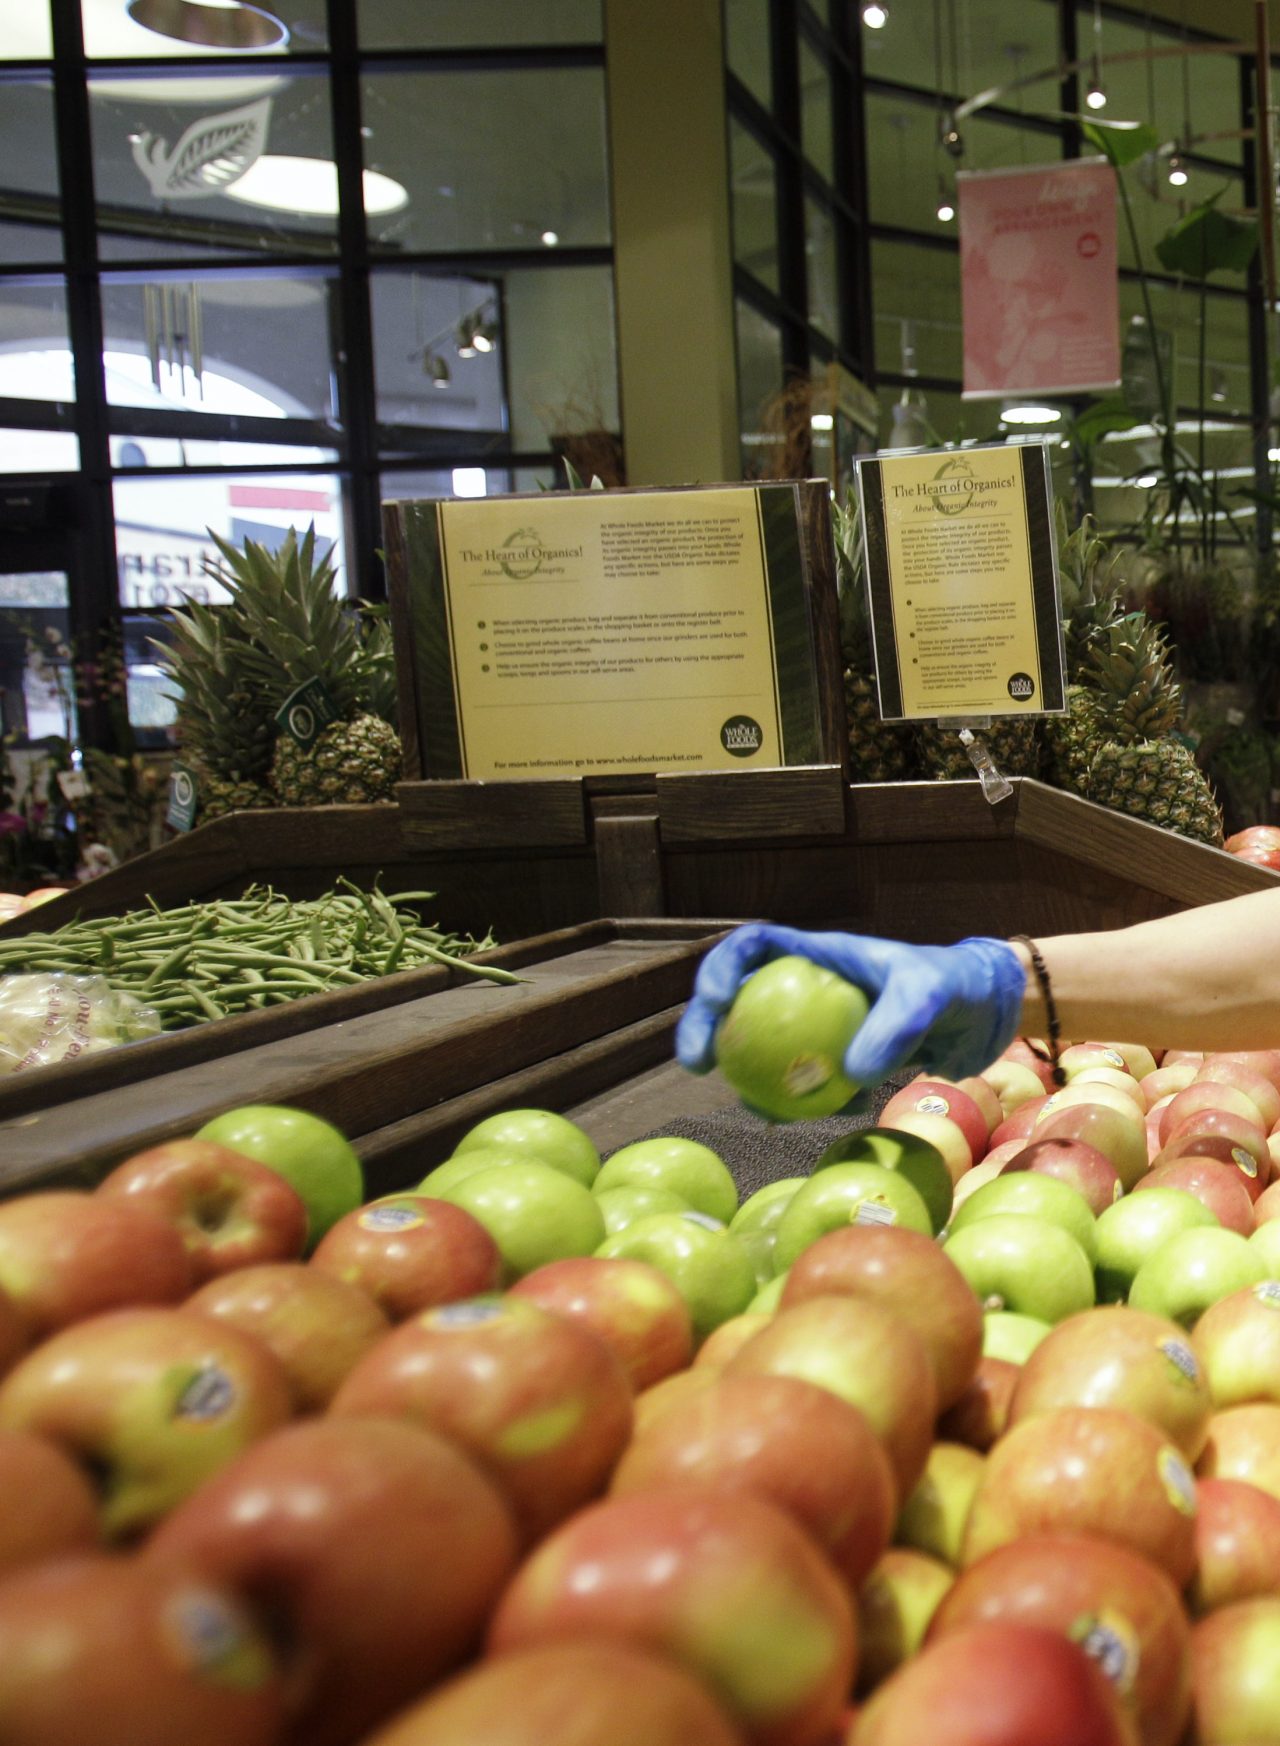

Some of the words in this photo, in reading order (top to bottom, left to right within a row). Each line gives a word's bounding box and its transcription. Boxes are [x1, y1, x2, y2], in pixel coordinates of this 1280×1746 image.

[892, 483, 914, 499] The
[916, 481, 947, 497] Heart
[950, 479, 960, 493] of
[964, 475, 1015, 494] Organics!
[459, 549, 482, 562] The
[485, 547, 515, 561] Heart
[518, 547, 529, 559] of
[531, 544, 583, 562] Organics!
[725, 724, 757, 737] WHOLE
[727, 735, 758, 745] FOODS
[494, 761, 506, 770] For
[508, 761, 528, 769] more
[530, 758, 573, 768] information
[575, 760, 584, 768] go
[586, 757, 594, 766] to
